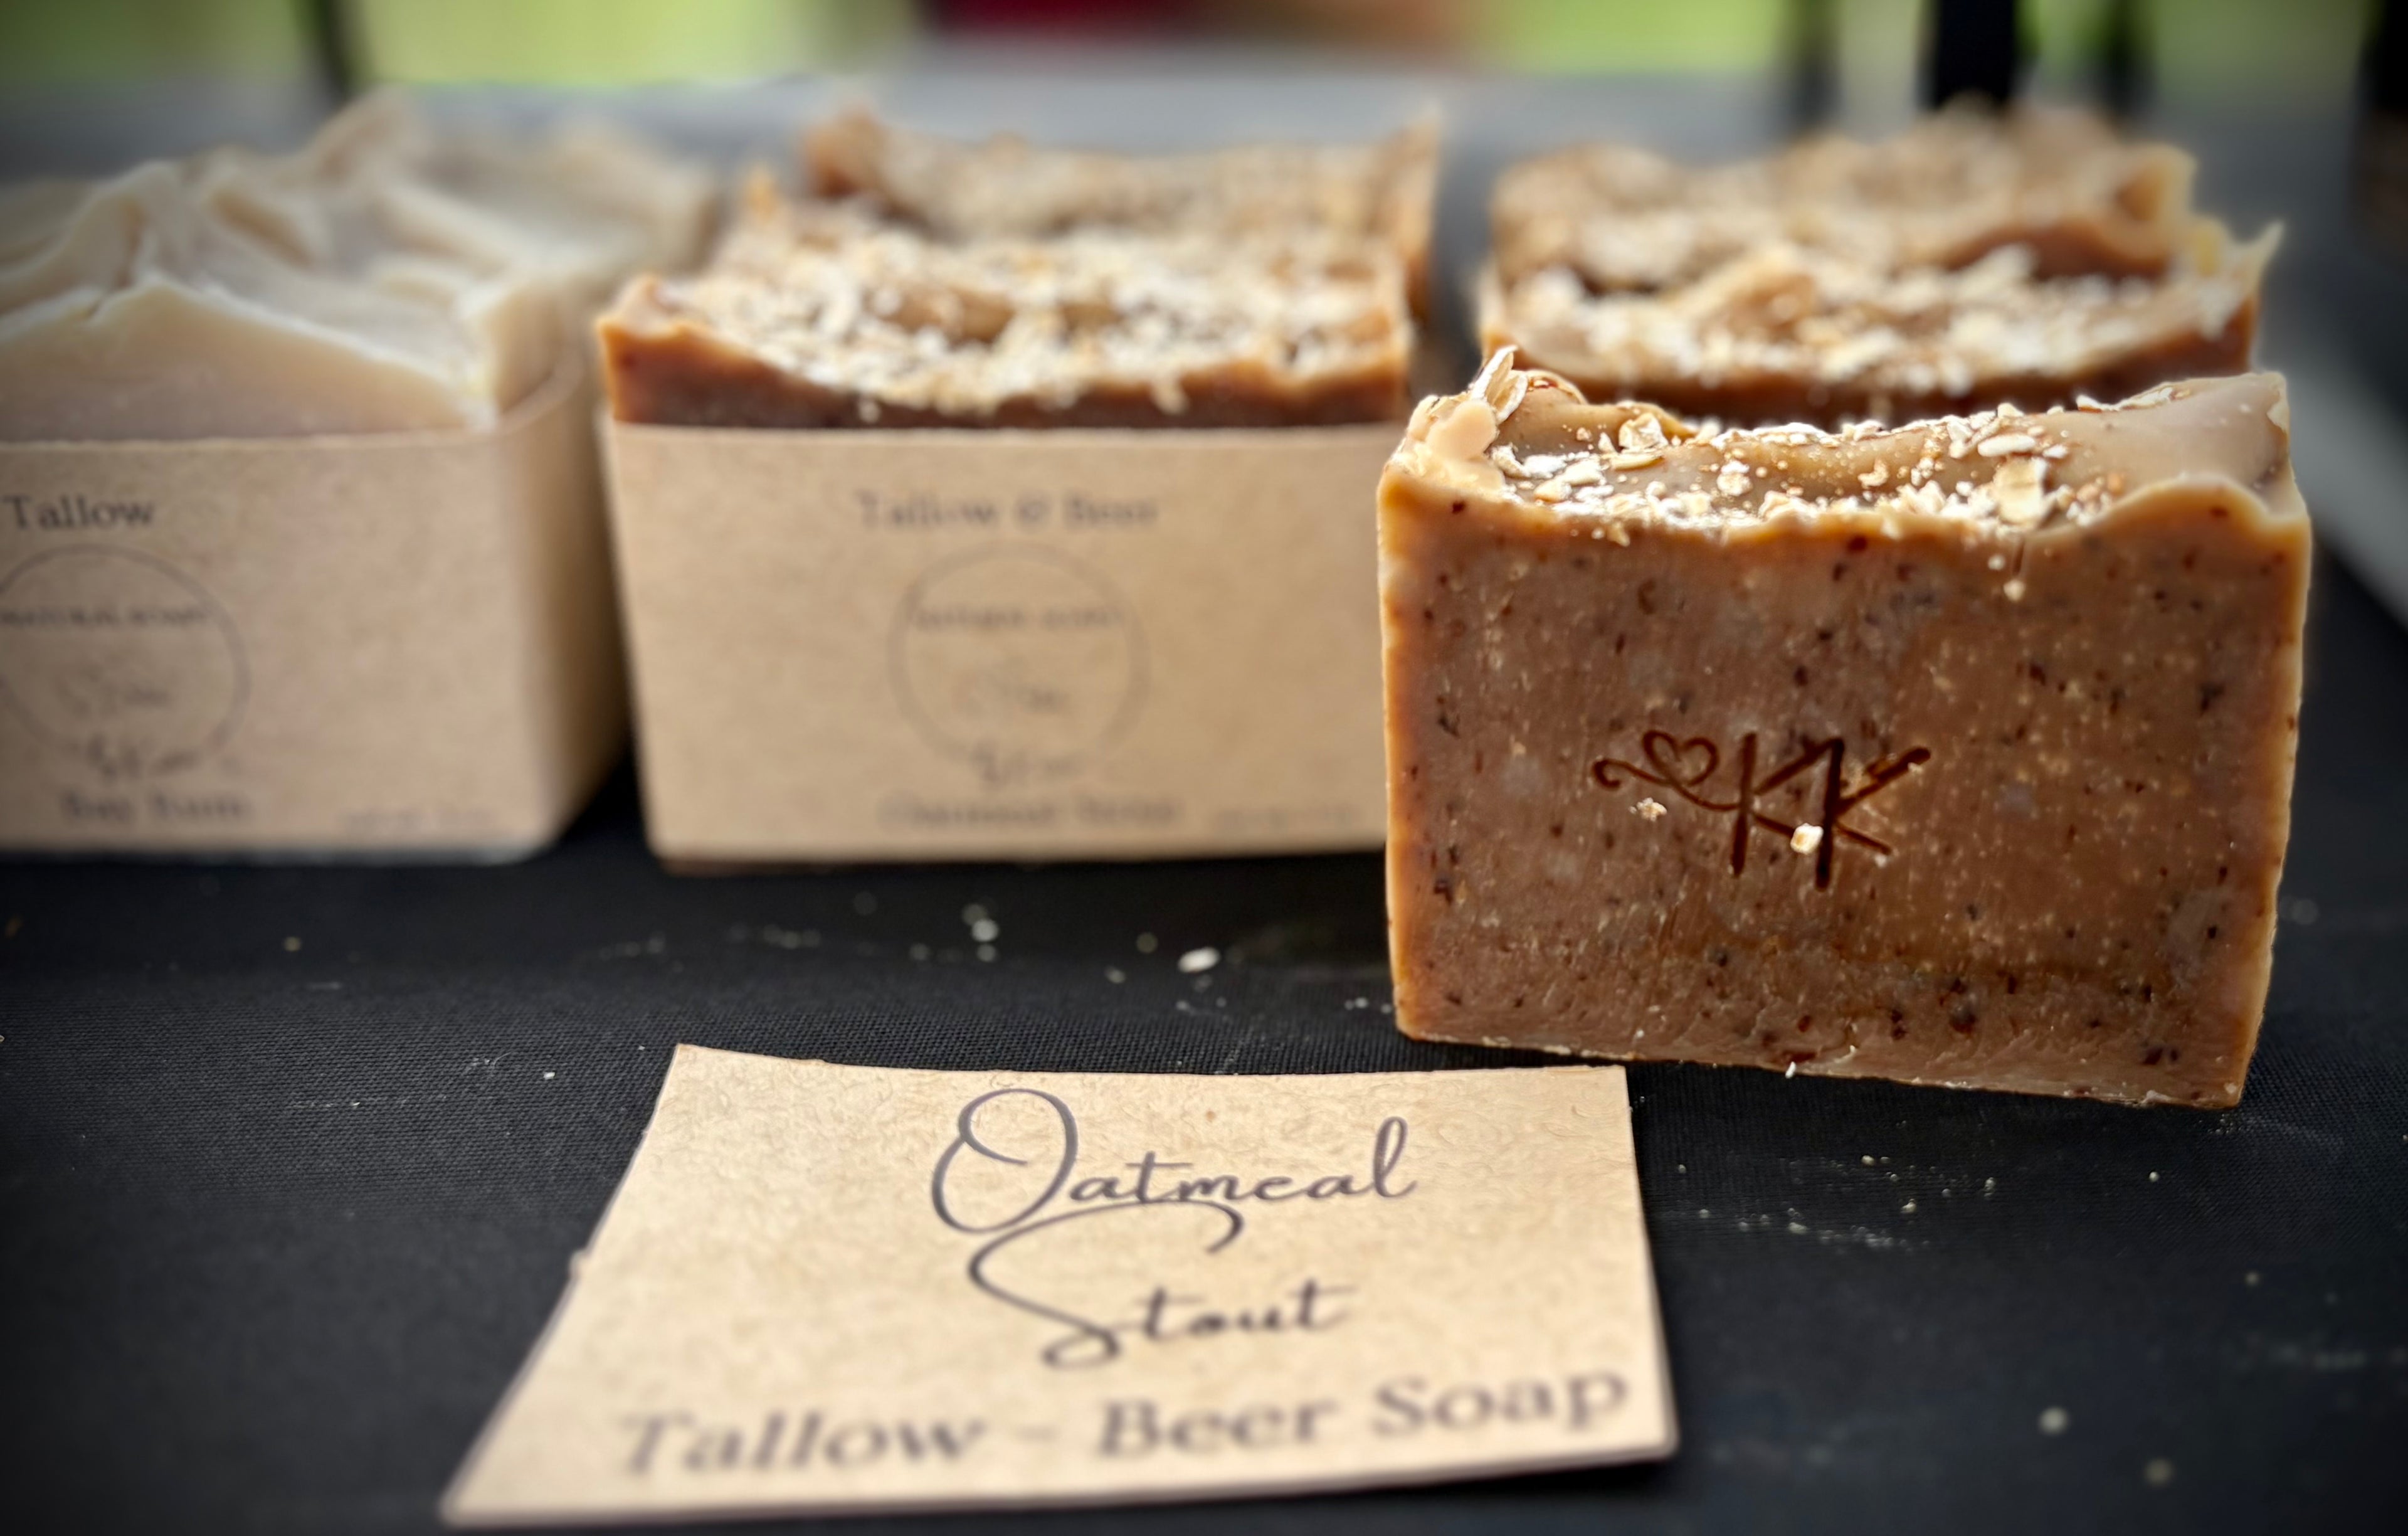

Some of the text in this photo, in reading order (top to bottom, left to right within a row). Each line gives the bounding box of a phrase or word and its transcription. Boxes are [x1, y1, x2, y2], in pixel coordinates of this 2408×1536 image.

[4, 494, 156, 531] Tallow
[853, 489, 999, 531] Tallow
[931, 1088, 1418, 1233] Oatmeal
[968, 1198, 1358, 1369] Stout
[620, 1407, 987, 1476] Tallow
[1096, 1397, 1341, 1459] Beer
[1371, 1371, 1629, 1439] Soap
